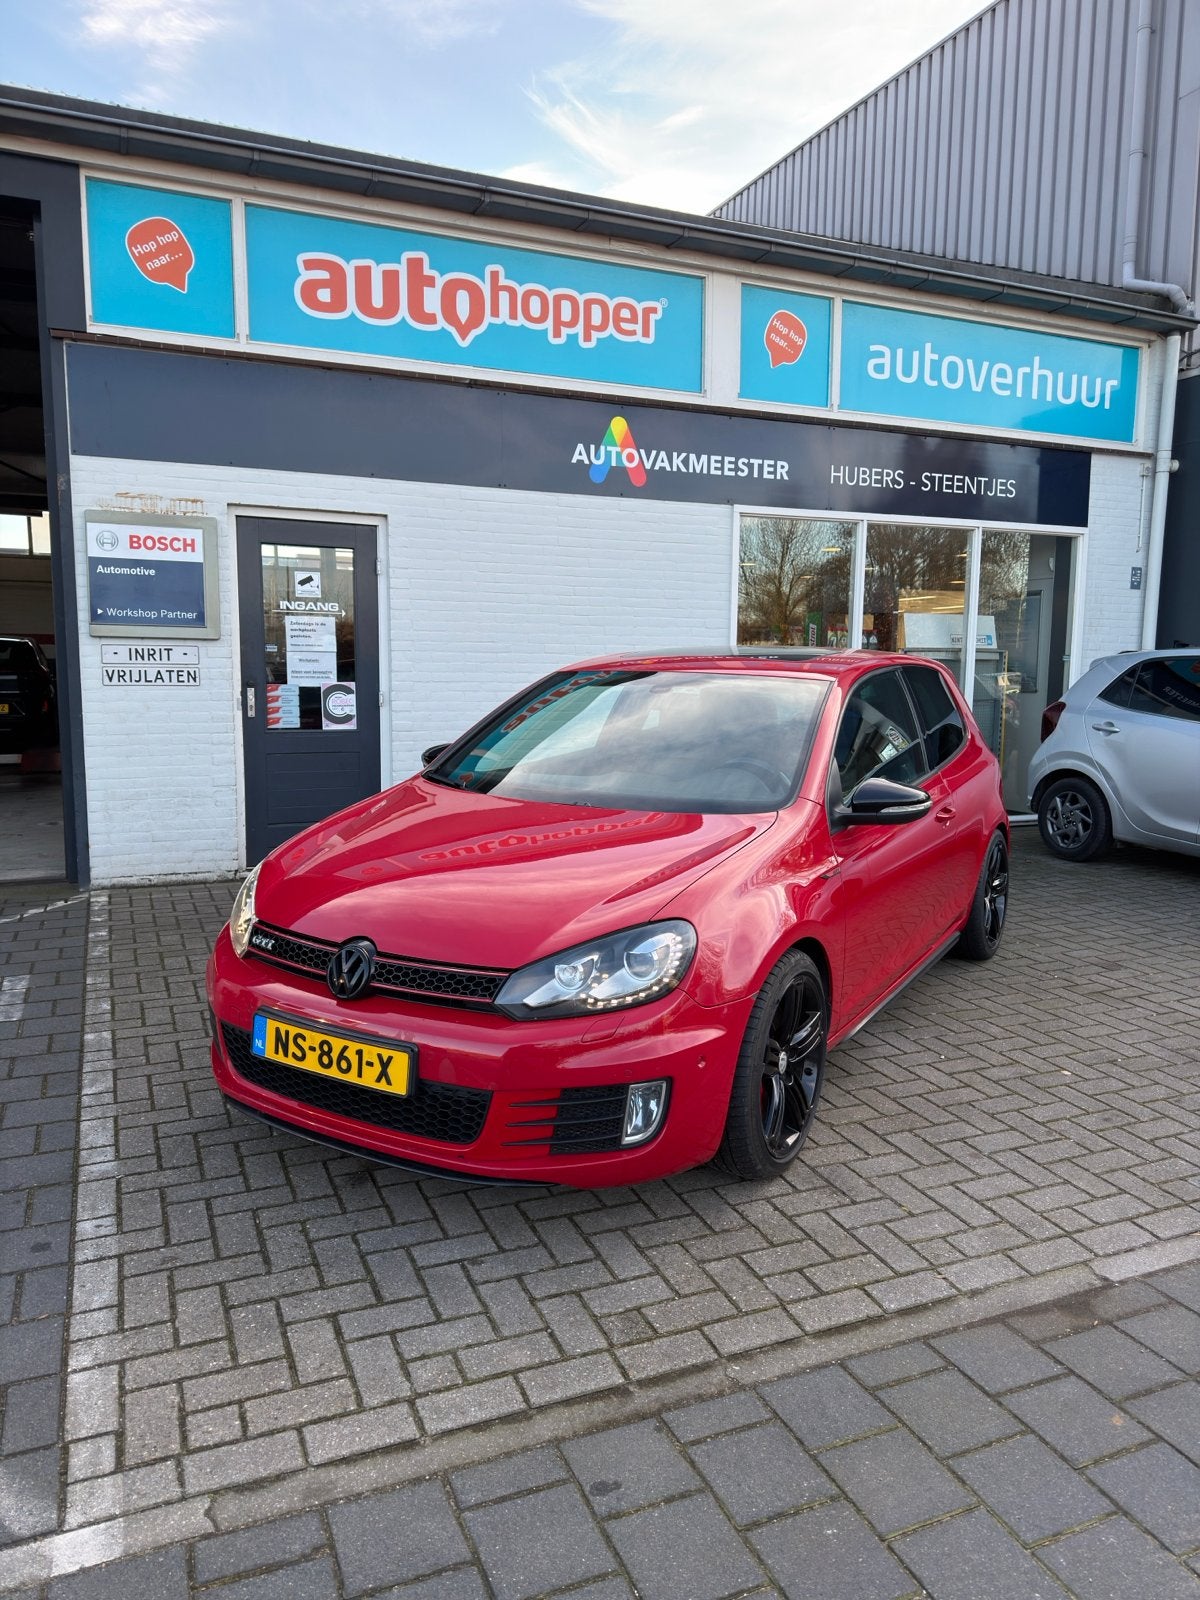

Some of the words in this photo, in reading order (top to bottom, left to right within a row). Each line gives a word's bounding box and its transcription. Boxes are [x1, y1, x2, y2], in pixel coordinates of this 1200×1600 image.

[131, 240, 158, 257] Hop
[156, 230, 179, 246] hop
[145, 253, 183, 271] naar...
[298, 255, 659, 343] autohopper
[772, 318, 789, 335] Hop
[789, 329, 804, 346] hop
[770, 333, 794, 354] naar...
[866, 342, 1119, 410] autoverhuur
[571, 442, 790, 481] AUTOVAKMEESTER
[830, 464, 905, 490] HUBERS
[920, 471, 1017, 498] STEENTJES
[128, 534, 196, 553] BOSCH
[96, 564, 156, 576] Automotive
[106, 607, 158, 619] Workshop
[160, 609, 198, 619] Partner
[279, 600, 339, 612] INGANG
[128, 647, 173, 662] INRIT
[105, 669, 197, 684] VRIJLATEN
[252, 935, 275, 950] GTI
[254, 1038, 265, 1050] NL
[273, 1025, 394, 1087] NS-861-X
